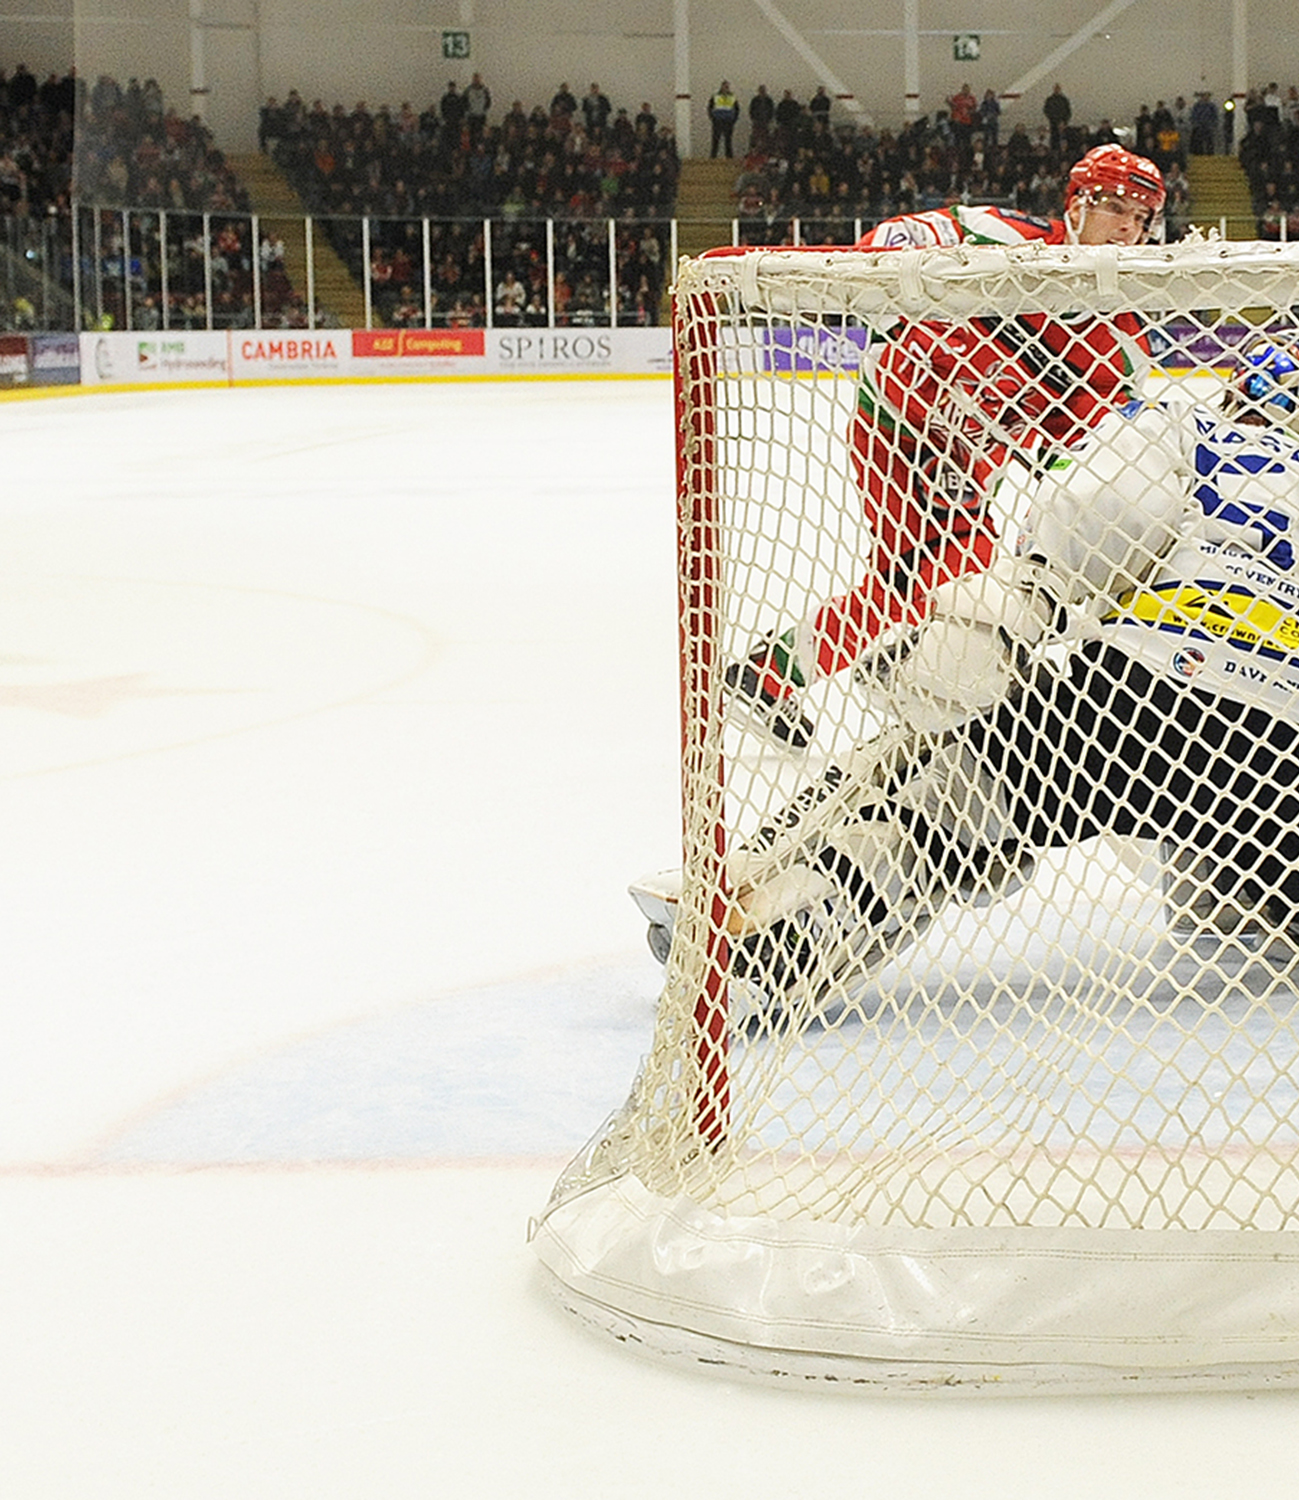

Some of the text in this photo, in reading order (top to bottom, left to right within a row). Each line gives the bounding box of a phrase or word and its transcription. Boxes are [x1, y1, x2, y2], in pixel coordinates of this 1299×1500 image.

[444, 36, 468, 56] 13
[242, 340, 337, 360] CAMBRIA
[499, 335, 612, 360] SPIROS
